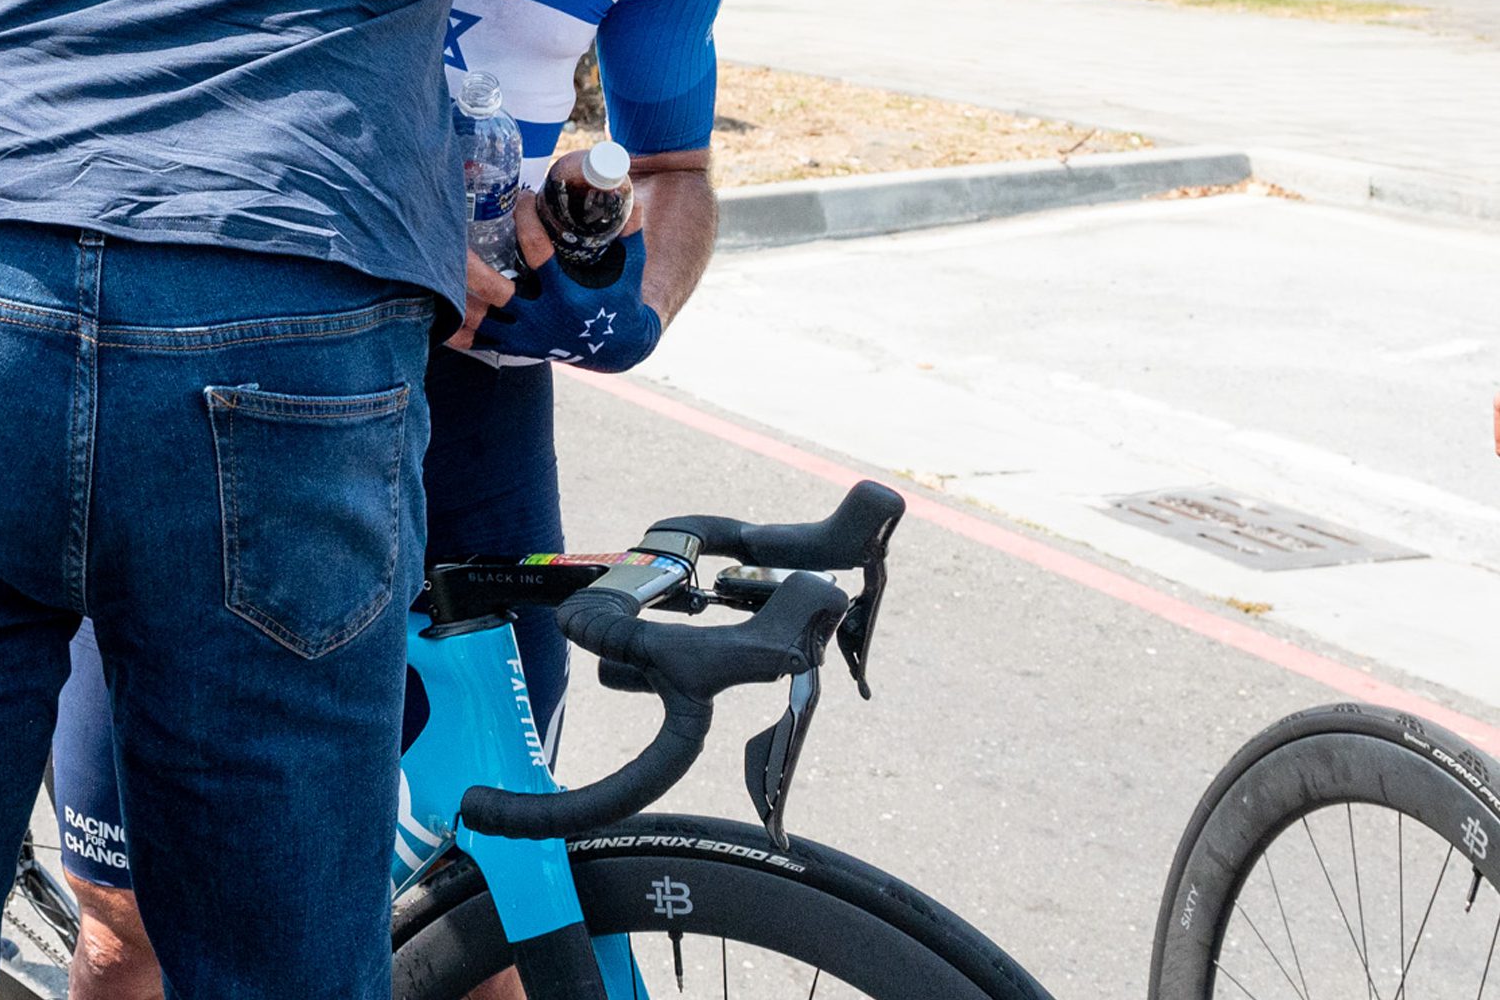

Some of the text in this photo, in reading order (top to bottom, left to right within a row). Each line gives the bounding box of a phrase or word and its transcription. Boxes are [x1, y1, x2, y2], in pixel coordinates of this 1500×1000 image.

[468, 572, 544, 585] BLACK INC
[64, 831, 130, 870] CHANG
[85, 833, 106, 849] FOR
[635, 835, 695, 848] PRIX
[696, 838, 766, 861] 5000
[1181, 883, 1199, 931] SIXTY
